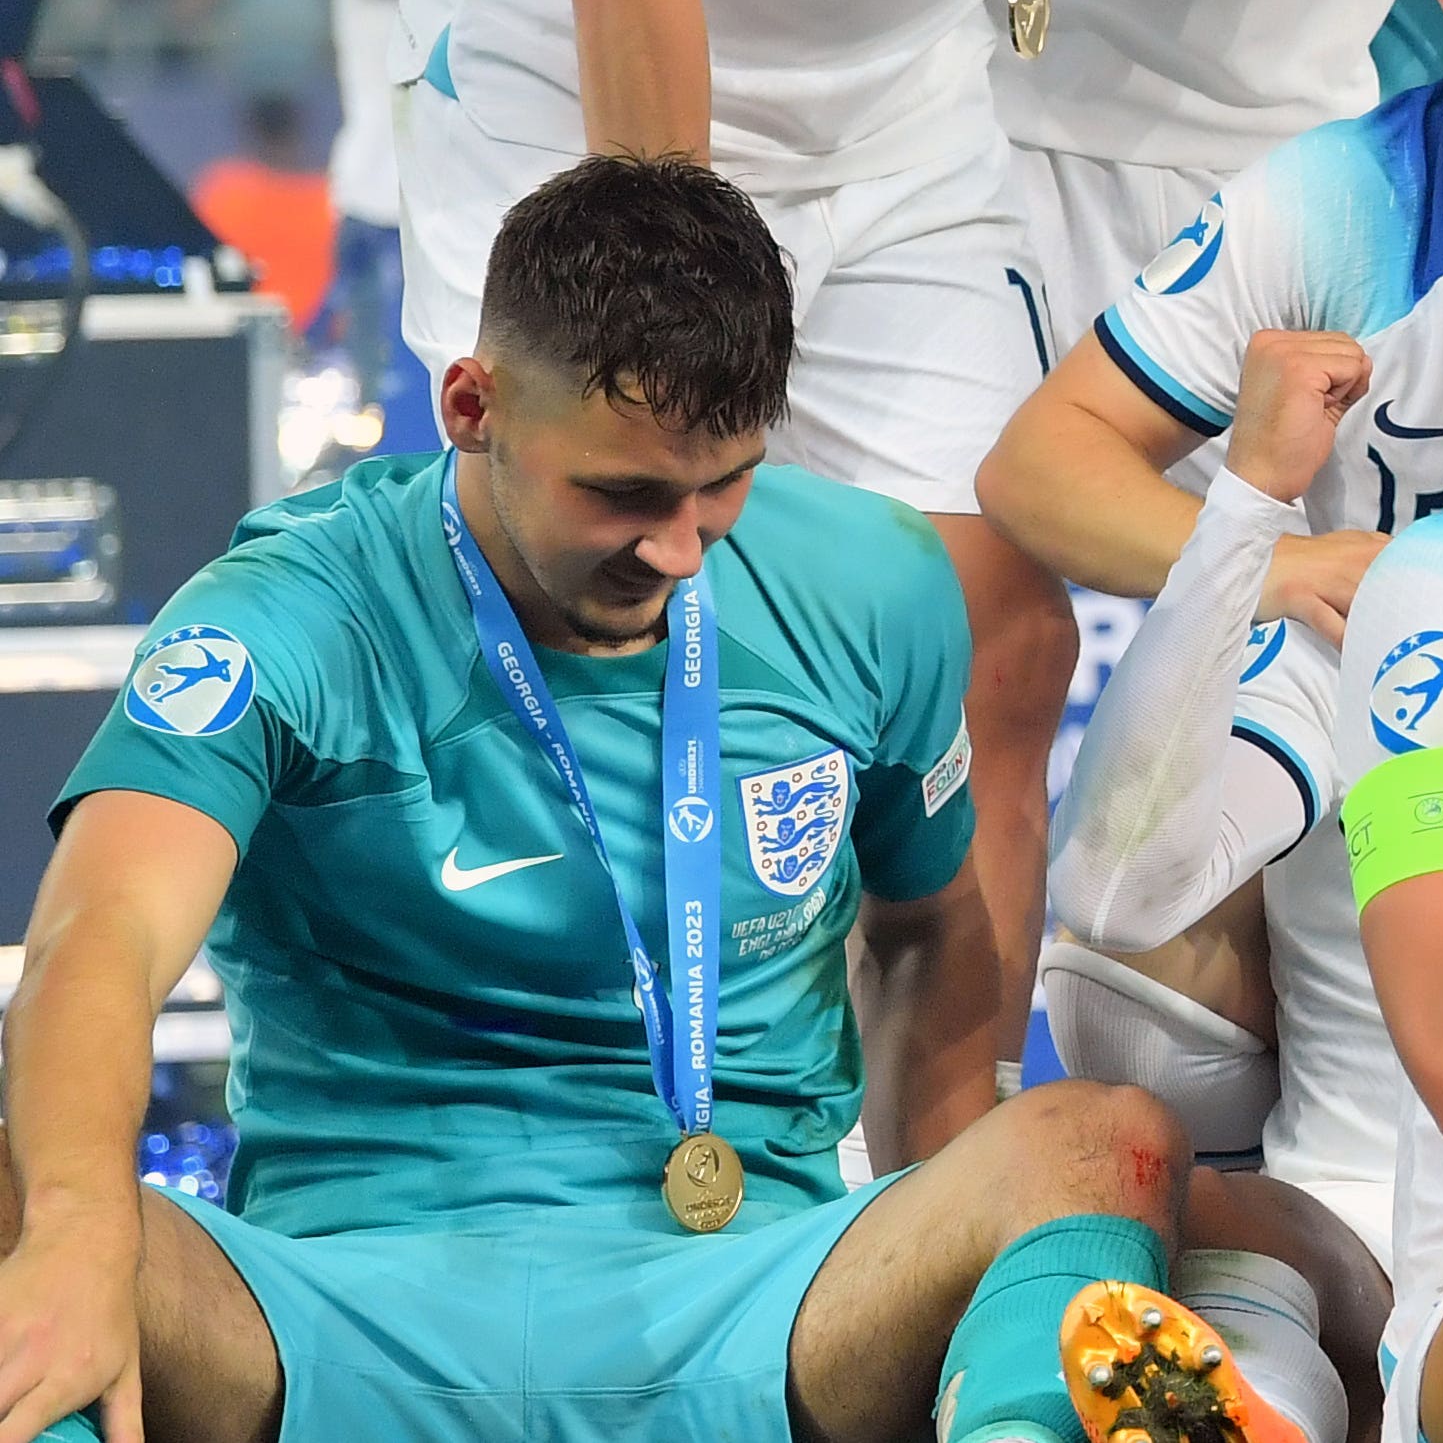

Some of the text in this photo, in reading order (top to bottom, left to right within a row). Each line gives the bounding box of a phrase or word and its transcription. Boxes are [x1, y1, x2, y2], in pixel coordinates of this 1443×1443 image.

[684, 590, 702, 688] GEORGIA
[497, 641, 549, 731] GEORGIA
[685, 900, 703, 959] 2023
[732, 908, 791, 939] UEFA U21
[687, 963, 706, 1070] ROMANIA
